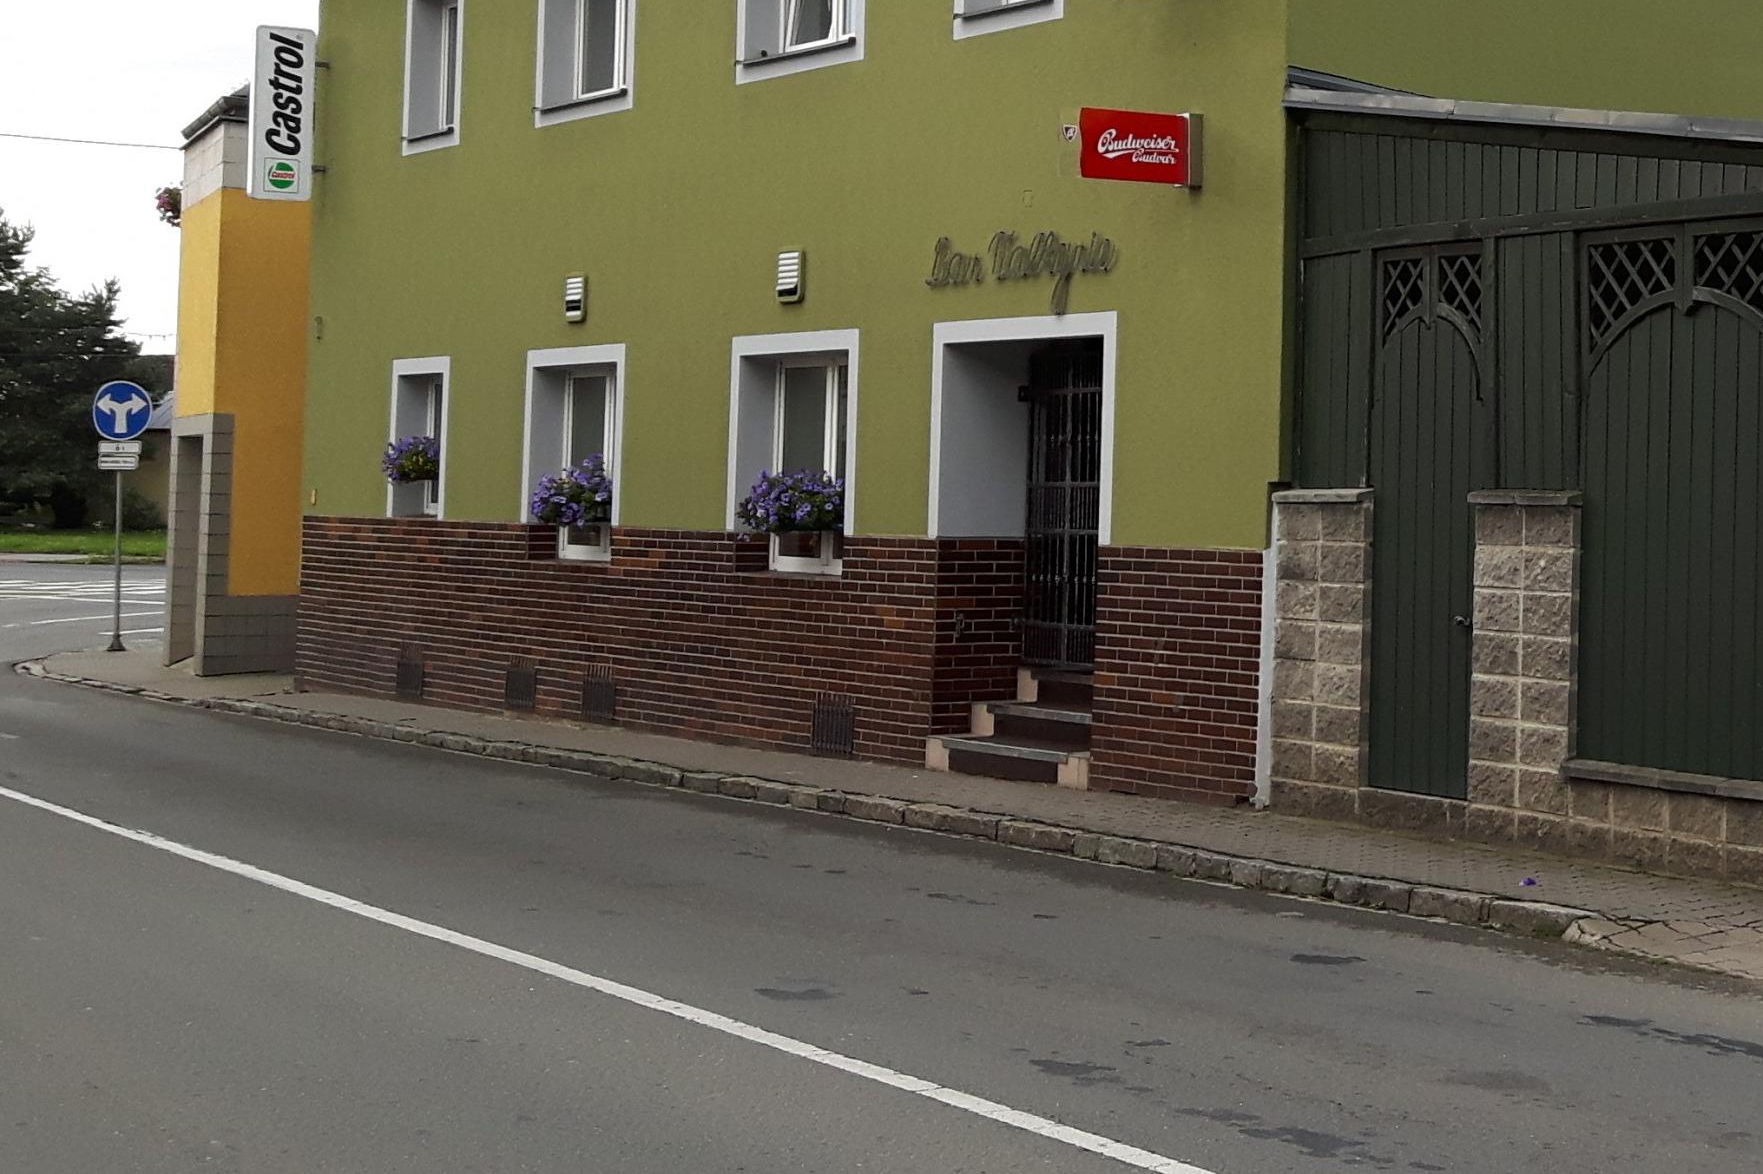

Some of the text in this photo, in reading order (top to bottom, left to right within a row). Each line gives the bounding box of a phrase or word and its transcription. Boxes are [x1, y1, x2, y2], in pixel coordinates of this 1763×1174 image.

[265, 32, 304, 156] Castrol
[1098, 128, 1179, 158] Budweiser
[1132, 148, 1176, 164] Budvar
